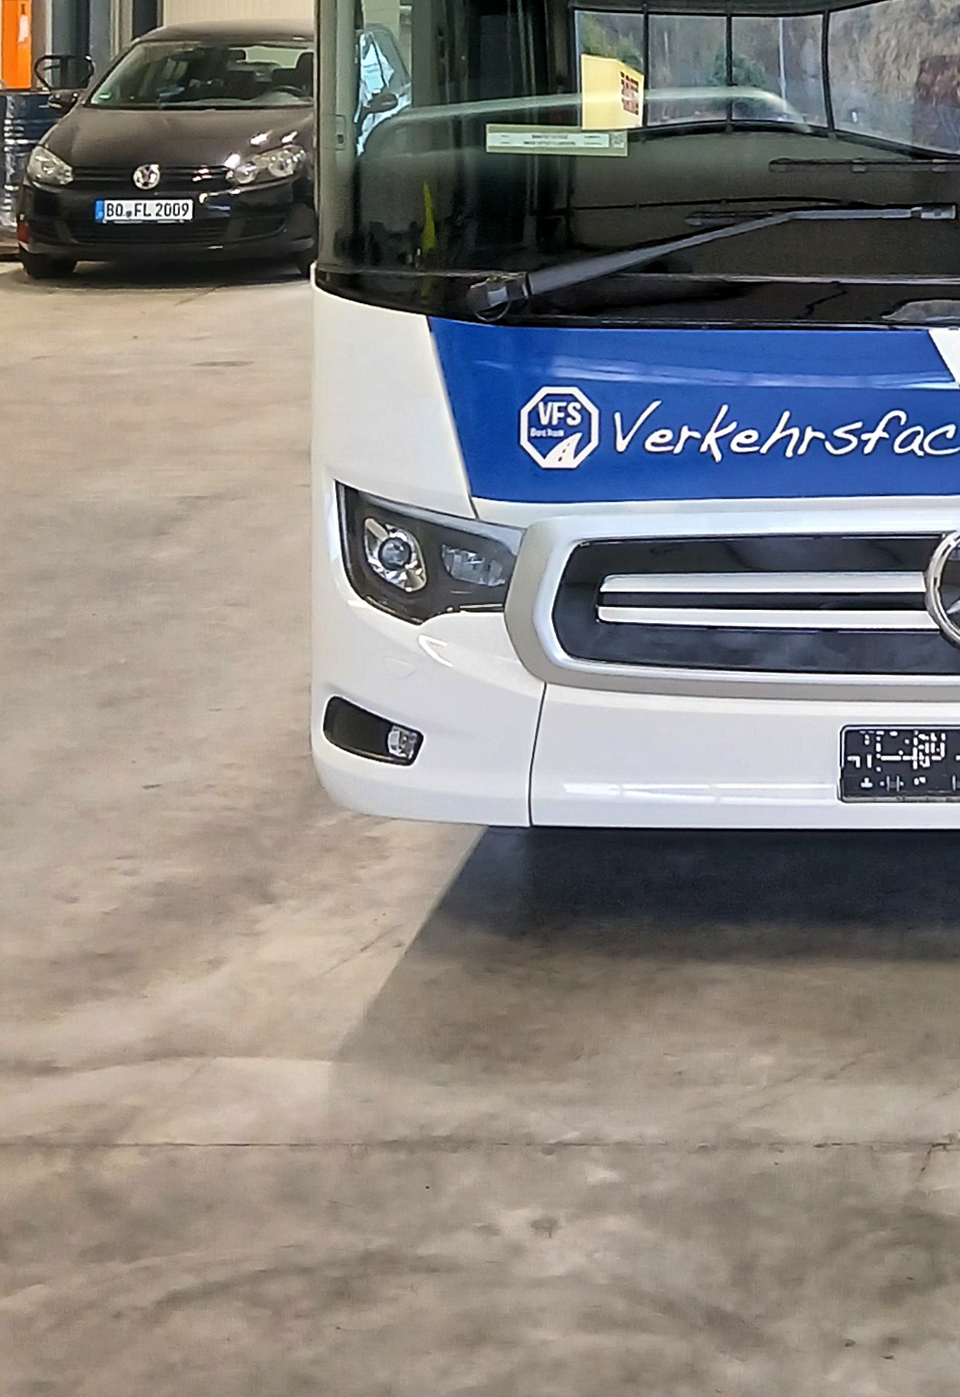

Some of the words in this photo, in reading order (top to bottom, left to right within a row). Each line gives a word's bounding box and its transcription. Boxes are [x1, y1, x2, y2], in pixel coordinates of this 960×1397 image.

[106, 203, 123, 217] BO
[134, 203, 151, 217] FL
[155, 203, 189, 217] 2009
[538, 401, 582, 426] VFS
